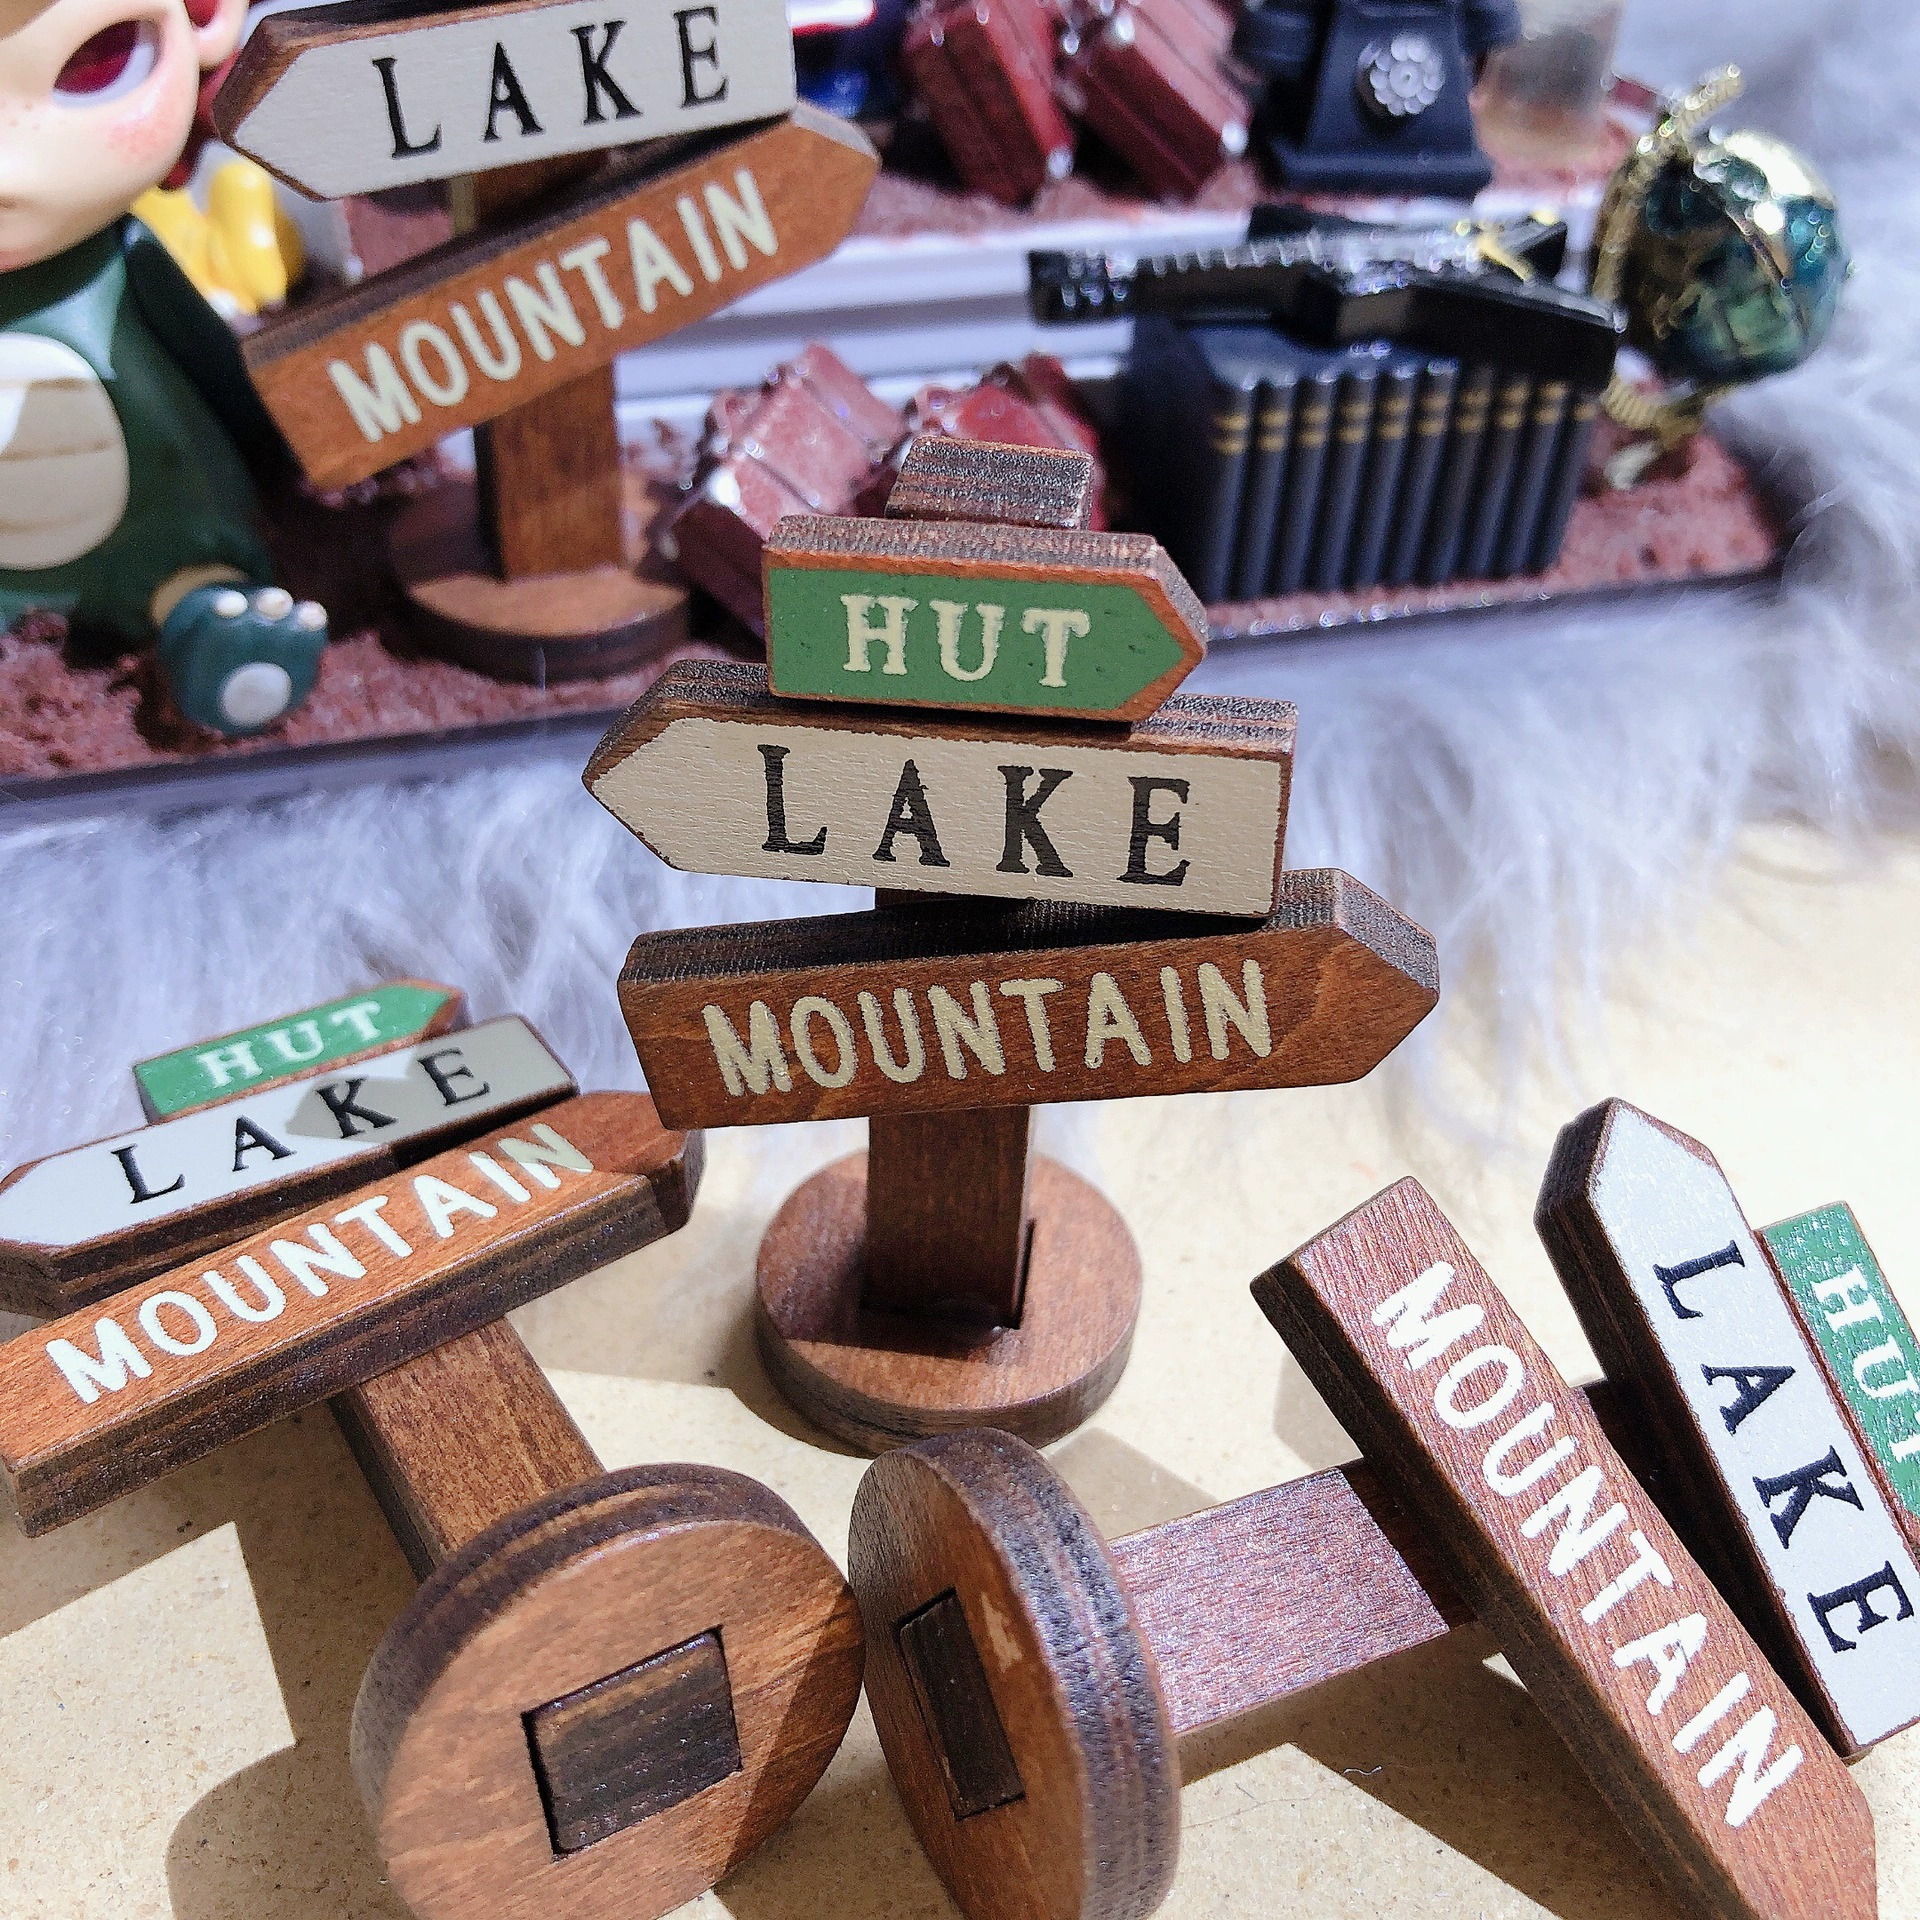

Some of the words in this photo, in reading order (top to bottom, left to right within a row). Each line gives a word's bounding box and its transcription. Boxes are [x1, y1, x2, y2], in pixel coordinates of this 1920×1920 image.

[372, 6, 729, 160] LAKE
[328, 170, 778, 442] MOUNTAIN
[841, 593, 1091, 688] HUT
[756, 744, 1190, 886] LAKE
[197, 1001, 382, 1088] HUT
[703, 958, 1272, 1097] MOUNTAIN
[111, 1047, 491, 1204] LAKE
[44, 1123, 594, 1404] MOUNTAIN
[1653, 1239, 1914, 1654] LAKE
[1371, 1261, 1804, 1828] MOUNTAIN
